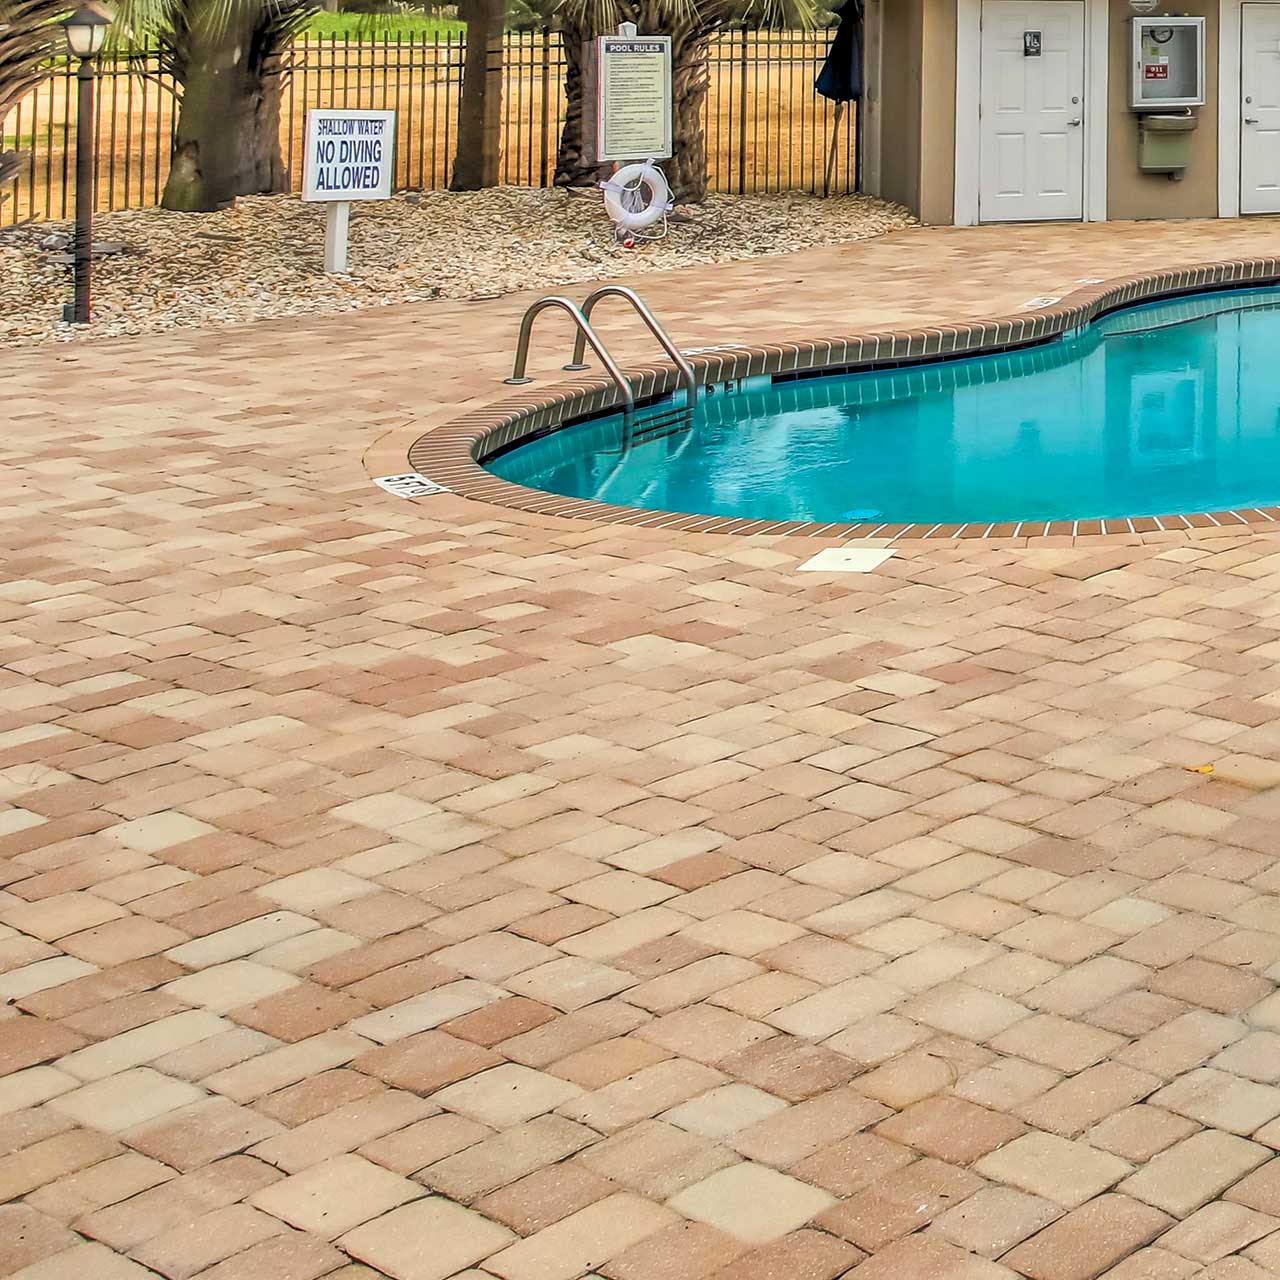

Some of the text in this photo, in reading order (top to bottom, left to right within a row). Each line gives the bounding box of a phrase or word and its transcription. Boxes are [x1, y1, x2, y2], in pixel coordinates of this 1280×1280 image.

[610, 44, 660, 52] POOL RULES
[318, 119, 384, 135] SHALLOW WATER
[316, 140, 382, 163] NO DIVING
[316, 166, 380, 190] ALLOWED
